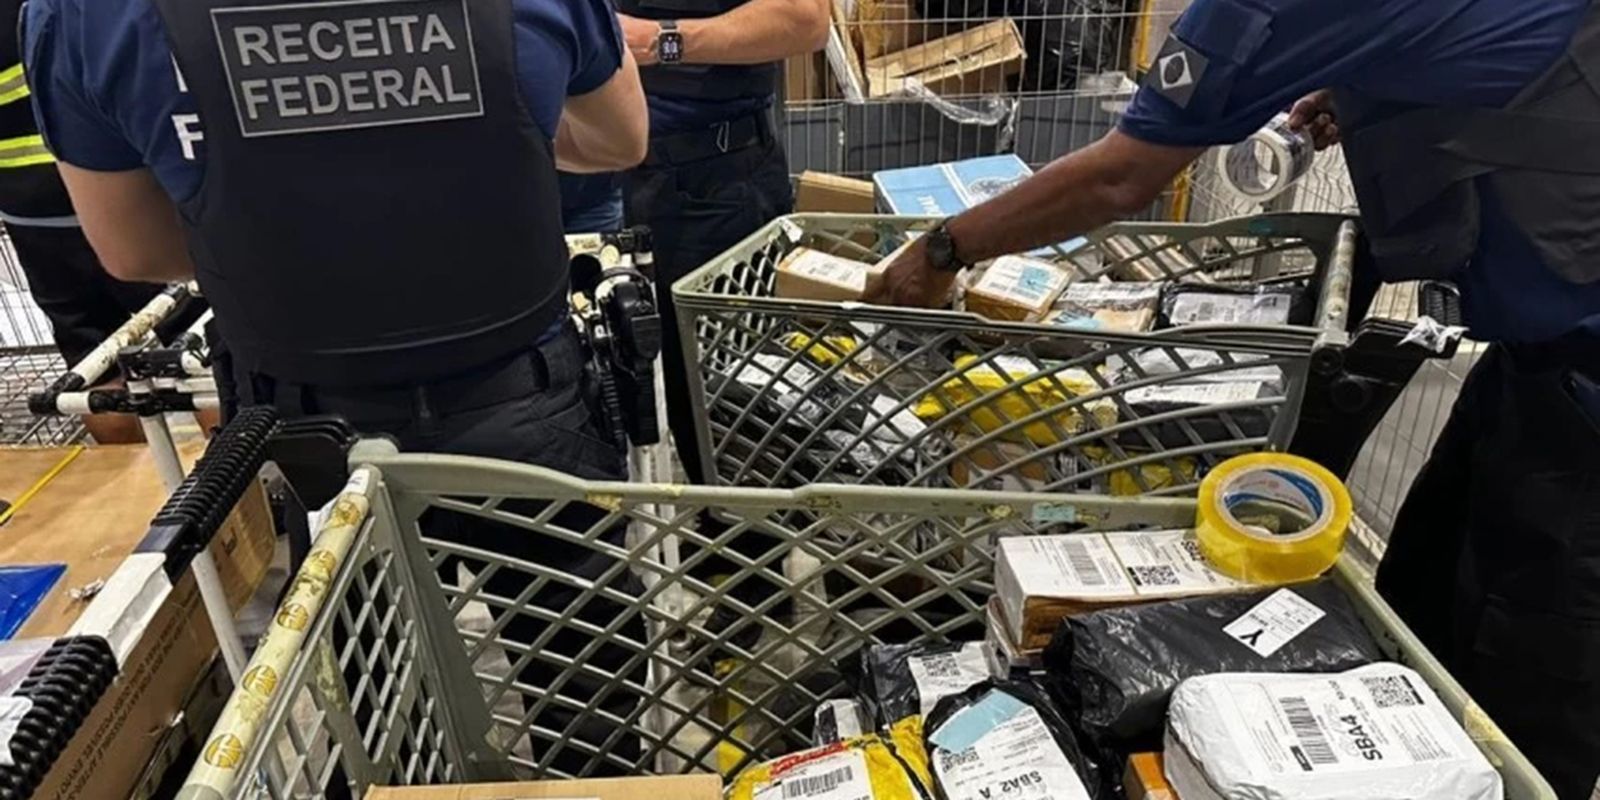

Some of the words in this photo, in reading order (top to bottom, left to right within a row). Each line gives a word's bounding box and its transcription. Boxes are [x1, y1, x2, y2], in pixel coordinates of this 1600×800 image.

[233, 14, 455, 66] RECEITA
[240, 65, 471, 120] FEDERAL
[1239, 629, 1264, 647] Y
[1340, 714, 1383, 761] SBA4
[998, 770, 1042, 793] SBA2
